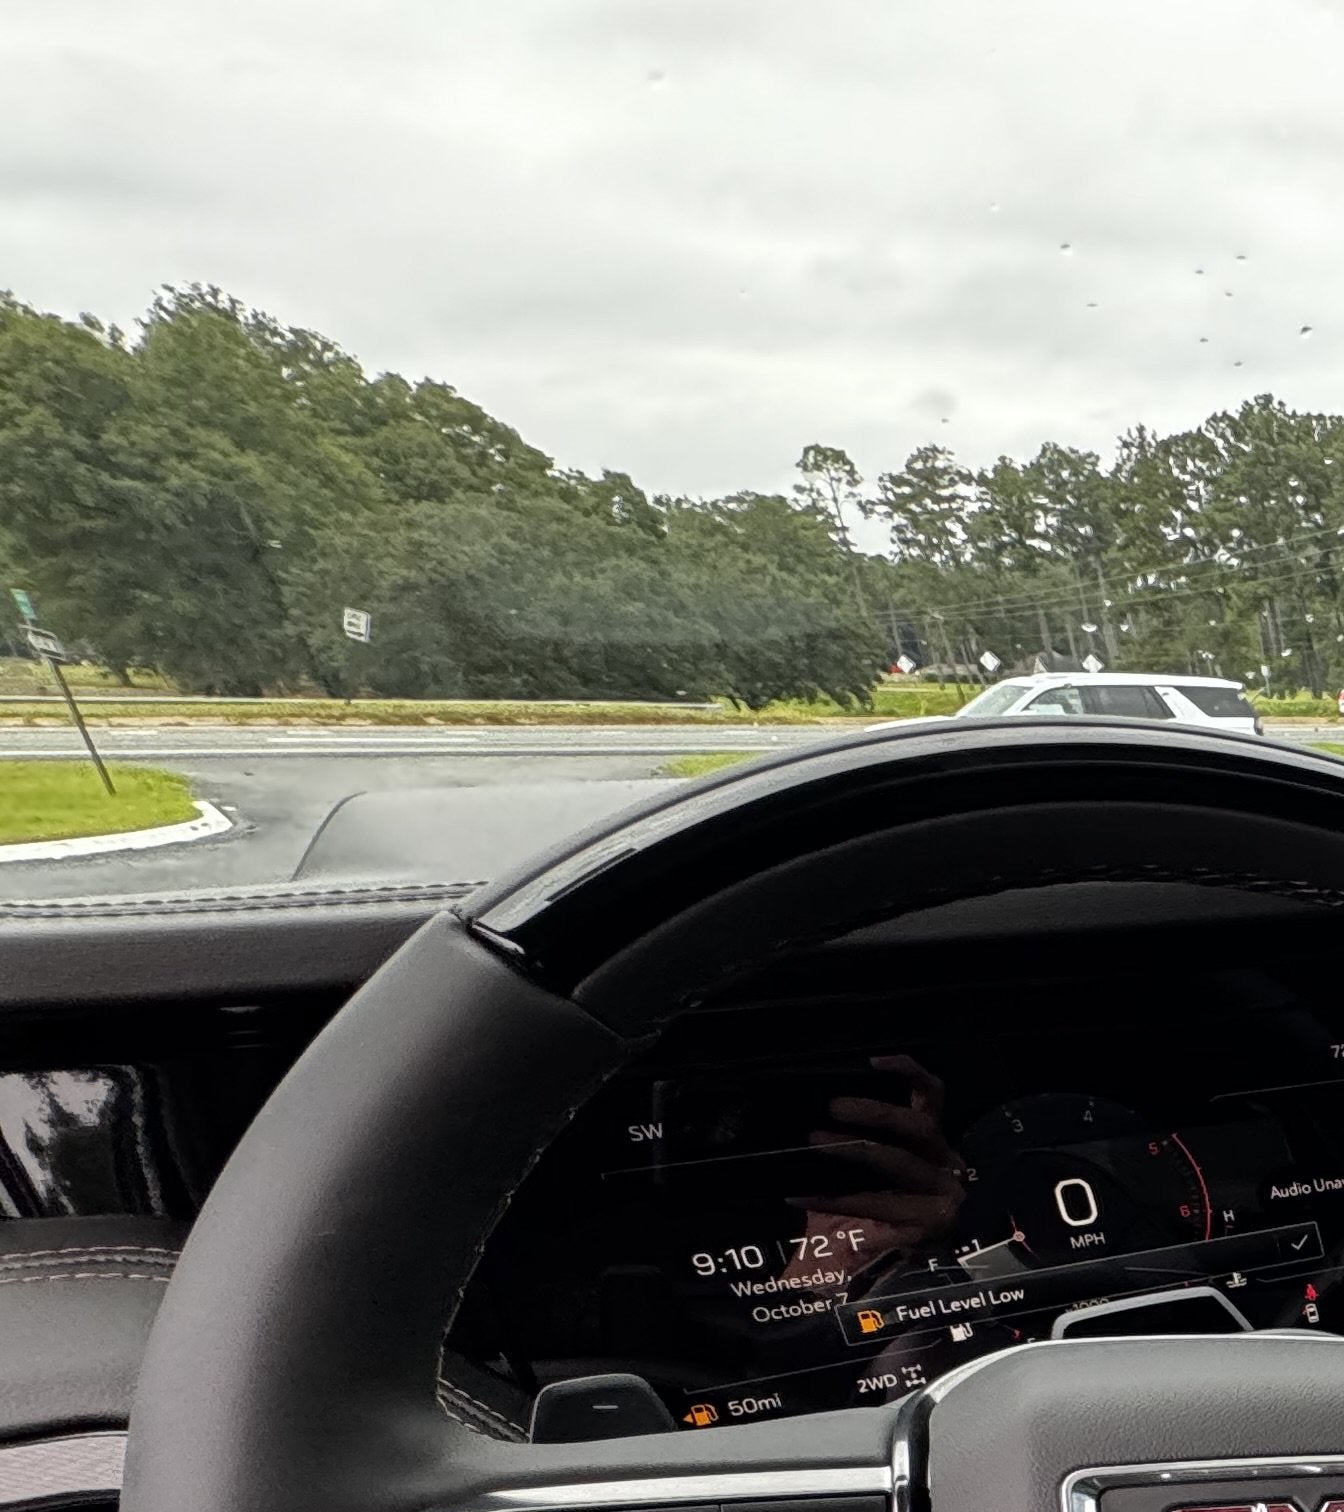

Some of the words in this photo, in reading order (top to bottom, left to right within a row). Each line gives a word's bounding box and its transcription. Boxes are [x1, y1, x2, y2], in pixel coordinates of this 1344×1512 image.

[1012, 1119, 1024, 1132] 3
[1083, 1110, 1093, 1122] 4
[628, 1122, 662, 1141] SW
[966, 1168, 978, 1181] 2
[1270, 1182, 1312, 1199] Audio
[1055, 1178, 1098, 1226] 0
[1222, 1210, 1234, 1222] H
[1070, 1231, 1106, 1249] MPH
[692, 1245, 764, 1276] 9:10
[790, 1235, 833, 1261] 72
[928, 1258, 938, 1272] F
[730, 1268, 852, 1298] Wednesday,
[752, 1298, 832, 1322] October
[896, 1300, 936, 1322] Fuel
[939, 1292, 986, 1314] Level
[988, 1289, 1025, 1304] Low
[857, 1374, 898, 1393] 2WD
[728, 1393, 782, 1416] 50mi
